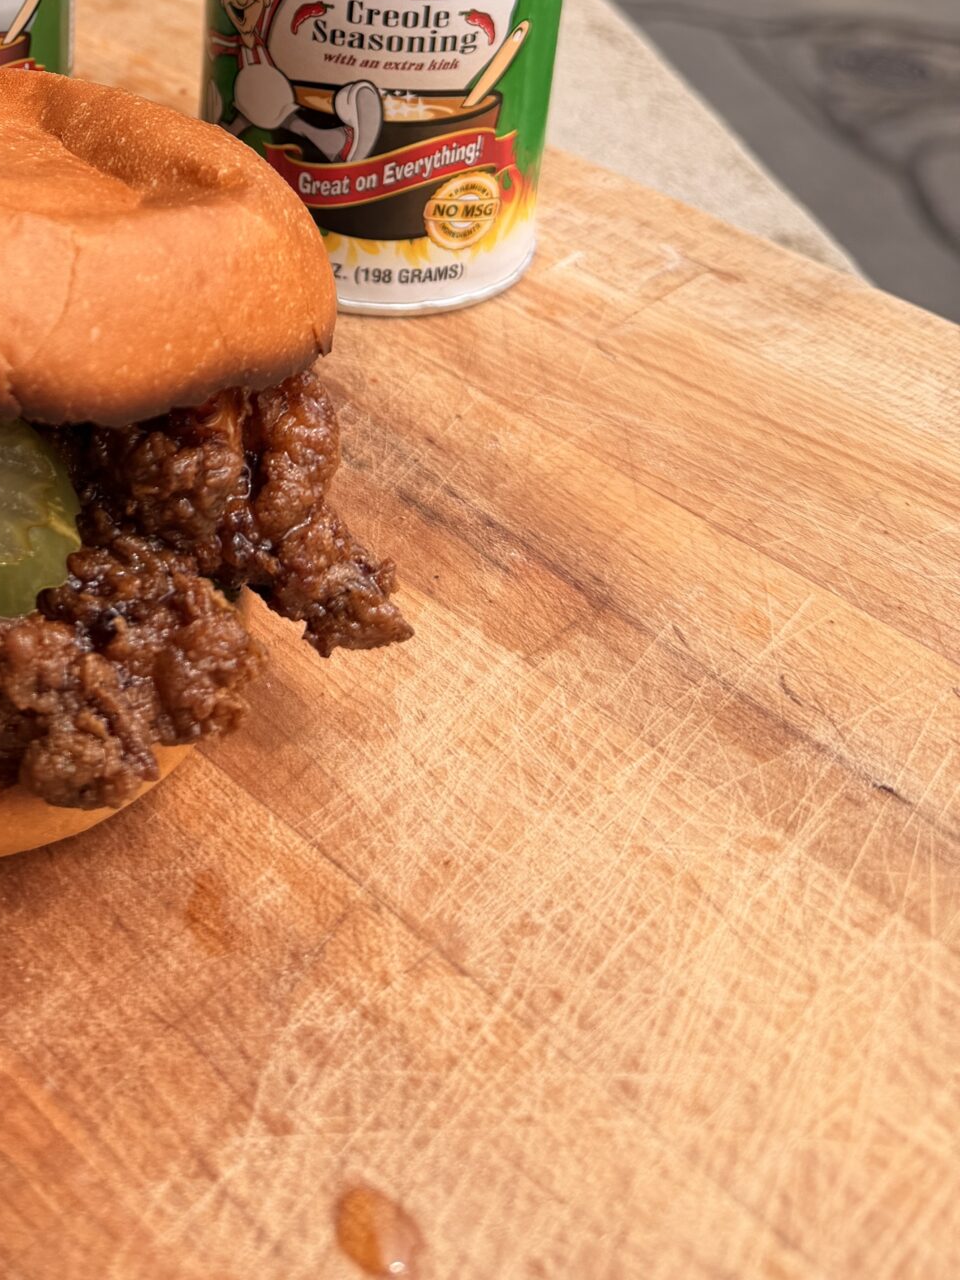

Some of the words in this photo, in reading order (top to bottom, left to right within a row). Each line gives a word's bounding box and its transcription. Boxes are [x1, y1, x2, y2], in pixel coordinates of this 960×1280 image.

[346, 0, 450, 29] Creole
[312, 19, 479, 55] Seasoning
[323, 52, 357, 68] with
[359, 58, 379, 69] an
[383, 60, 425, 71] extra
[428, 58, 460, 71] kick
[298, 171, 350, 197] Great
[355, 173, 378, 192] on
[382, 135, 483, 185] Everything!
[432, 204, 458, 218] NO
[461, 202, 494, 218] MSG
[332, 263, 347, 280] Z.
[354, 266, 392, 285] (198
[397, 263, 464, 284] GRAMS)
